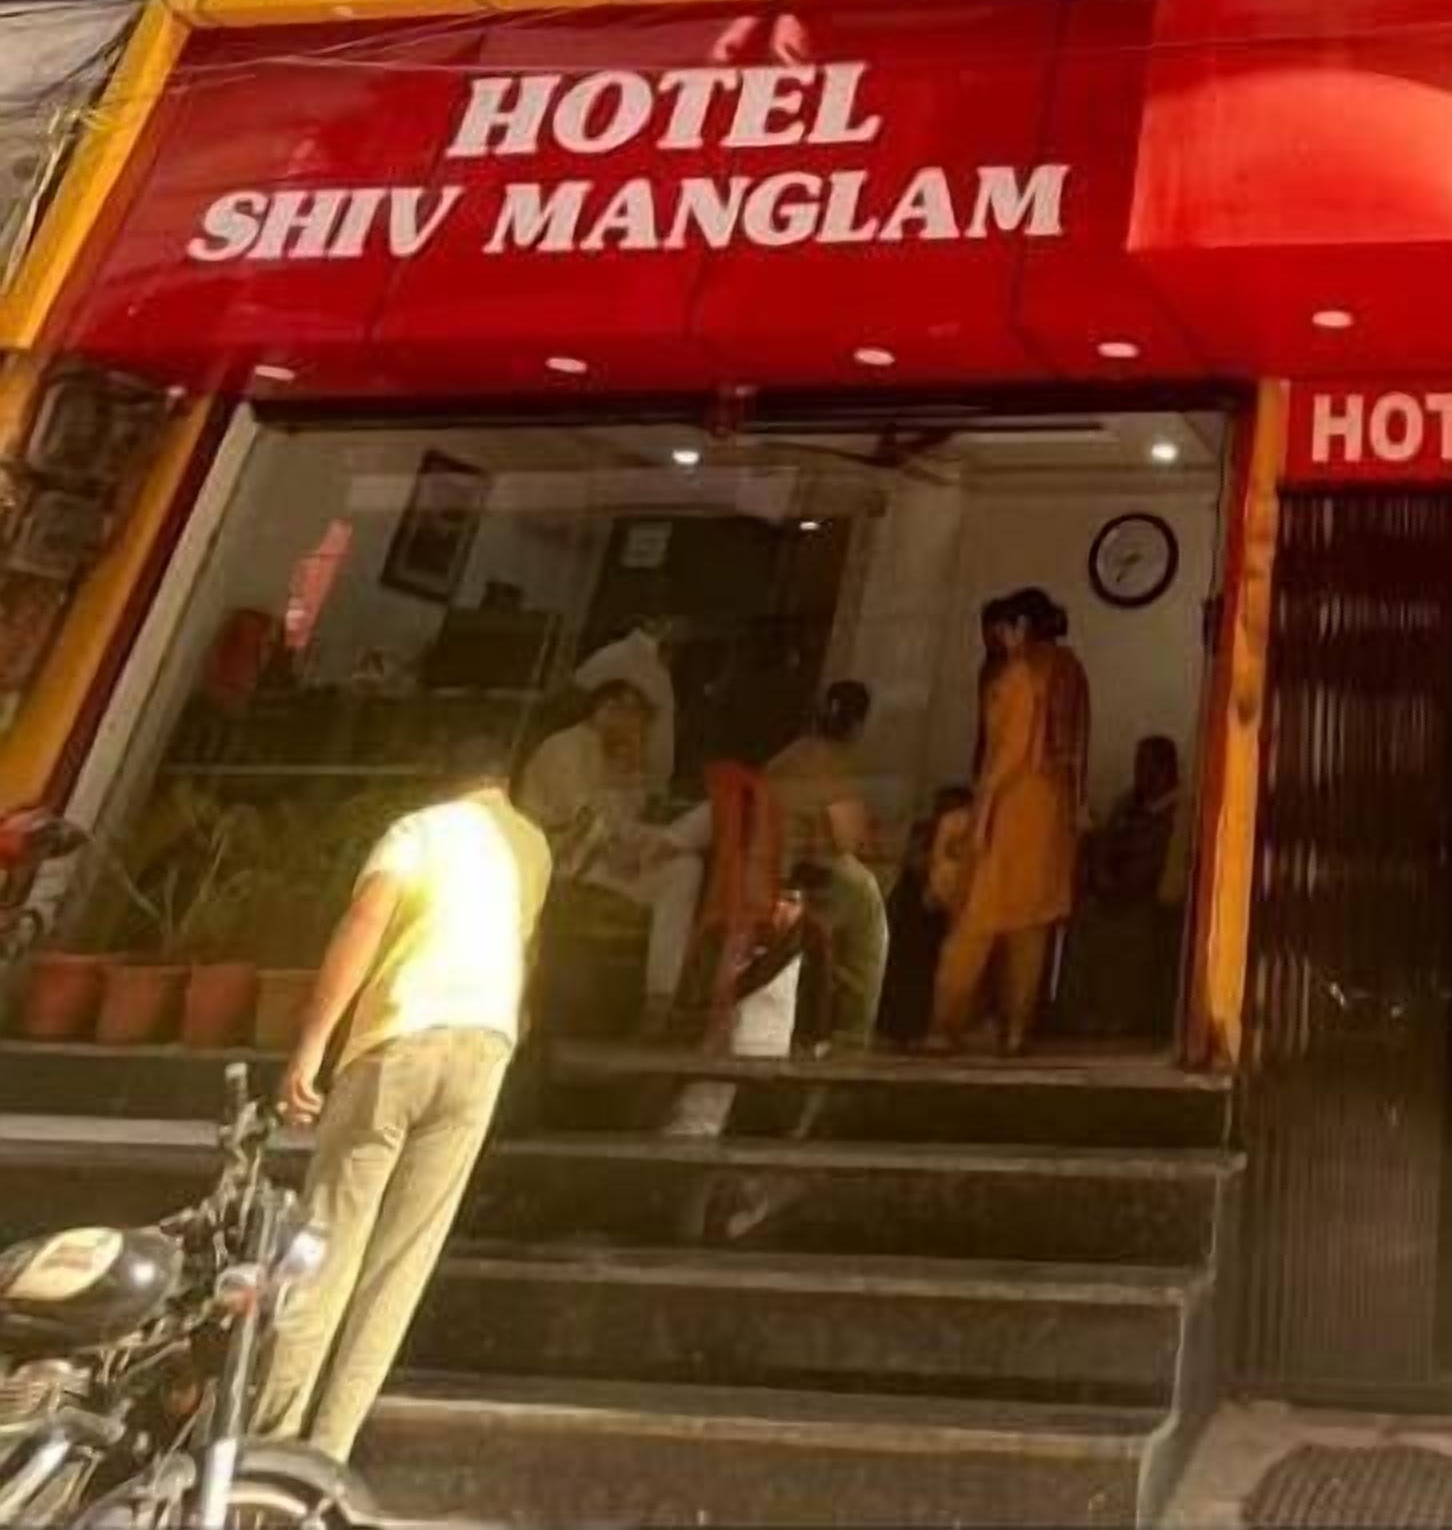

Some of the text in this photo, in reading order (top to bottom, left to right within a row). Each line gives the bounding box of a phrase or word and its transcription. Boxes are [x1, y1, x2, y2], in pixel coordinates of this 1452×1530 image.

[446, 62, 881, 158] HOTEL
[188, 164, 1069, 260] SHIV MANGLAM
